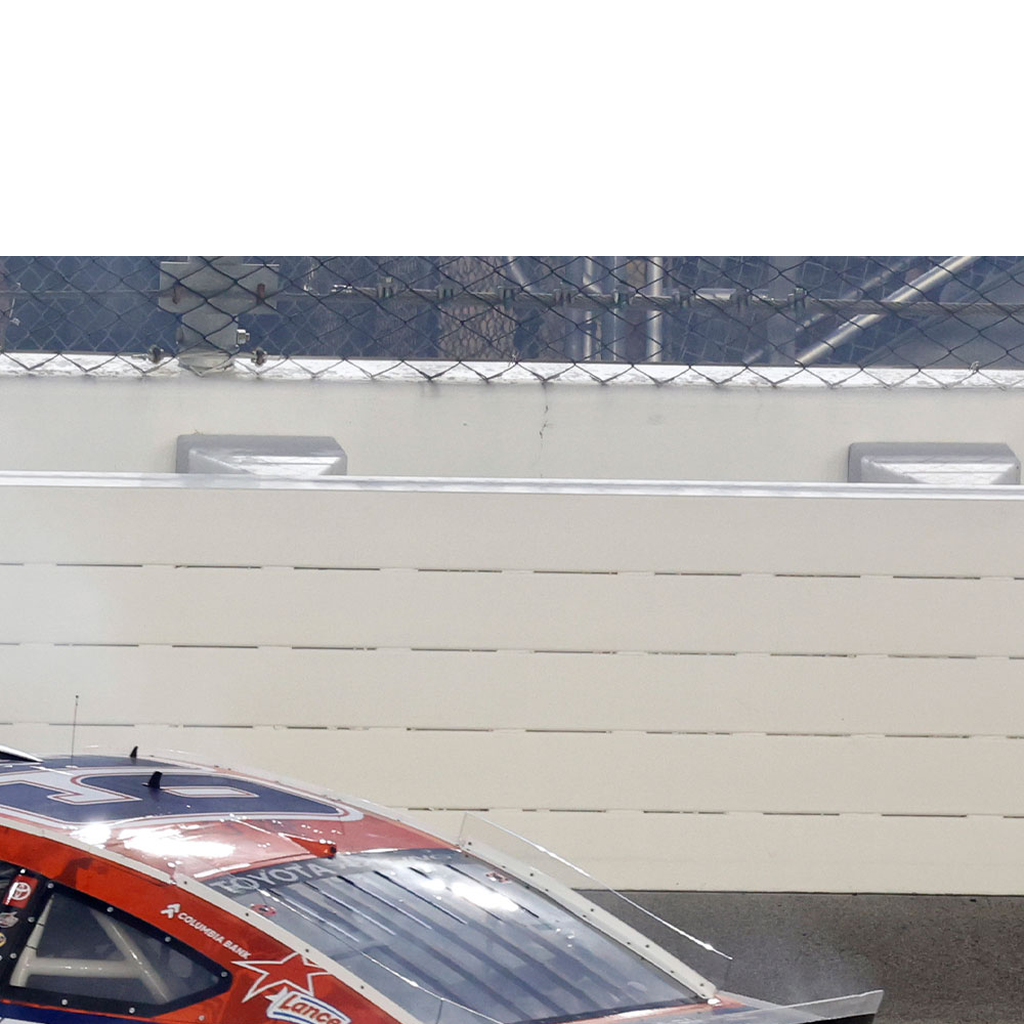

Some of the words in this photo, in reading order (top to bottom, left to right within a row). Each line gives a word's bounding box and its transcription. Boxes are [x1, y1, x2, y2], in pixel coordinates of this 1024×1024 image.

[210, 861, 338, 894] TOYOTA
[177, 912, 229, 946] COLUMBIA
[222, 939, 252, 960] BANK
